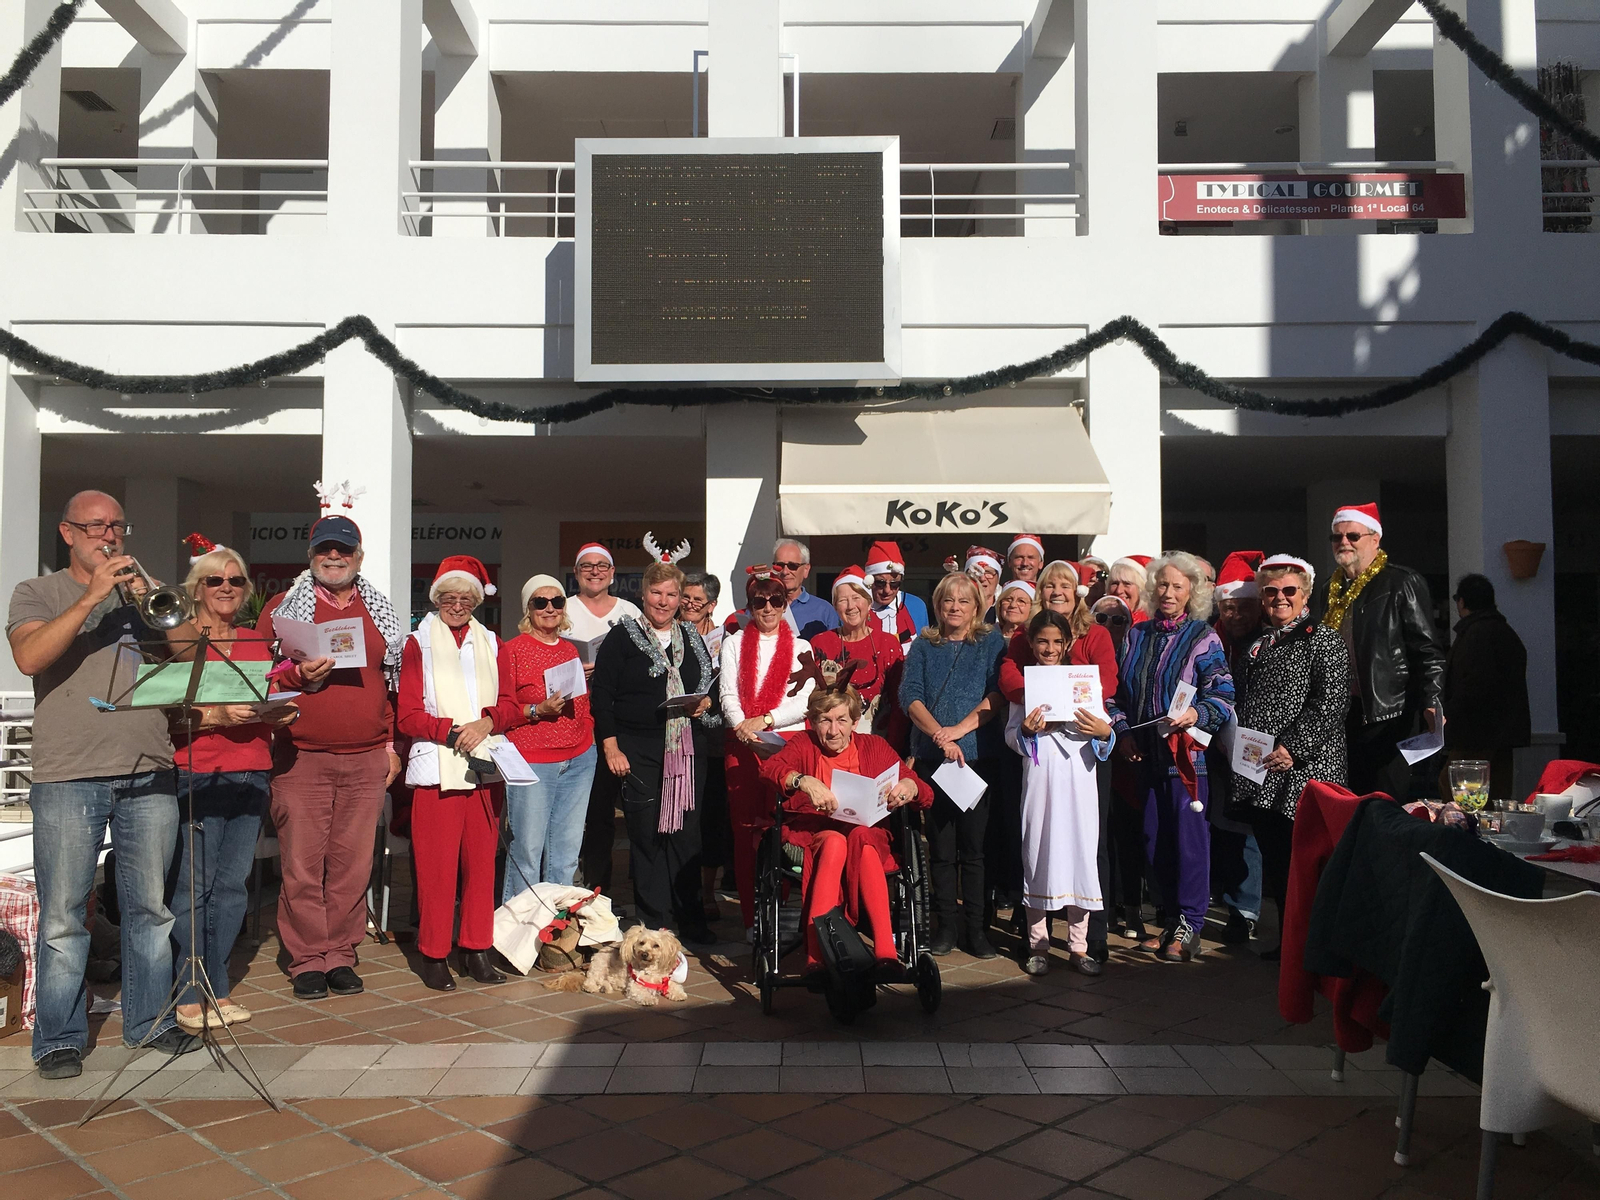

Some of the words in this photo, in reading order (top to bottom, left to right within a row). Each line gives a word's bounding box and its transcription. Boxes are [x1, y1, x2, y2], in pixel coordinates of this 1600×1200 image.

[1203, 183, 1301, 198] TYPICAL
[1313, 182, 1419, 197] GOURMET
[1196, 204, 1239, 214] Enoteca
[1242, 204, 1250, 214] &
[1253, 203, 1320, 214] Delicatessen
[1330, 203, 1364, 213] Planta
[1380, 203, 1409, 213] Local
[1412, 203, 1424, 212] 64
[324, 624, 356, 634] Bethlehem
